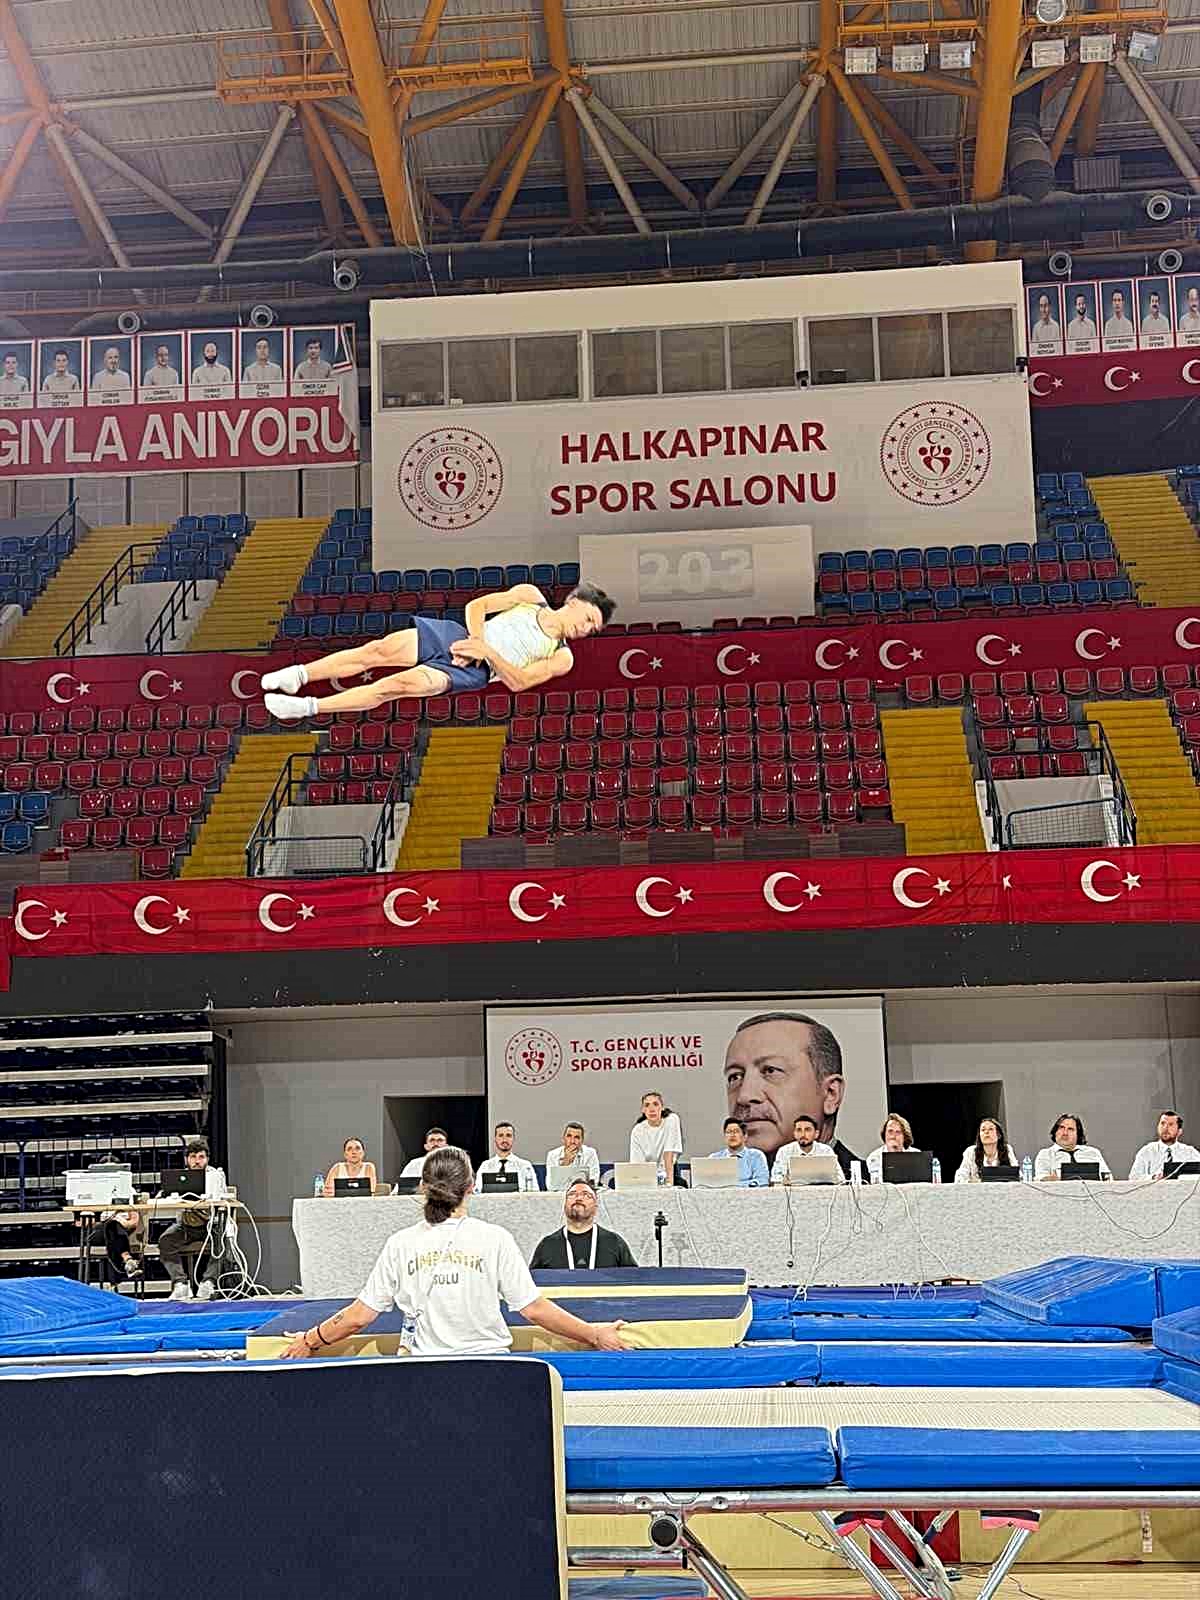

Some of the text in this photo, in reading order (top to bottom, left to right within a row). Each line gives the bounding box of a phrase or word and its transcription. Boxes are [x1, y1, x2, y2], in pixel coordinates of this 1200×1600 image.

[138, 406, 351, 460] ANIYORU
[561, 421, 828, 465] HALKAPINAR
[550, 472, 837, 515] SPOR SALONU
[571, 1034, 702, 1053] T.C. GENÇLİK VE
[571, 1052, 704, 1072] SPOR BAKANLIĞI
